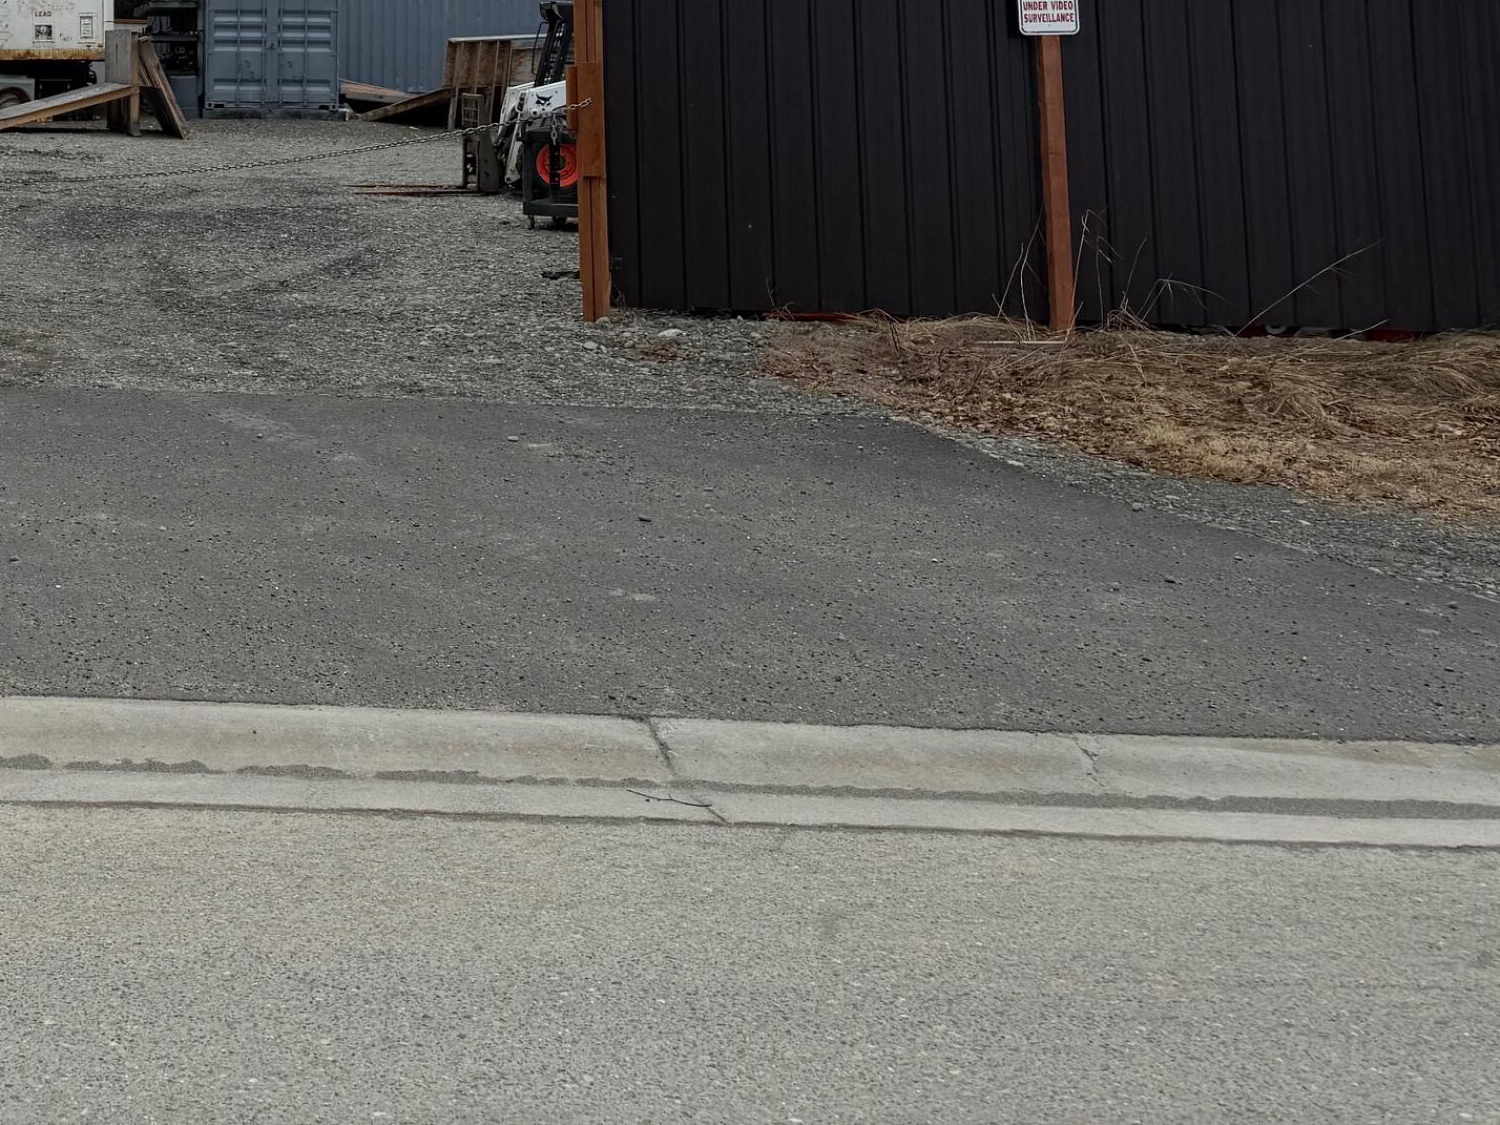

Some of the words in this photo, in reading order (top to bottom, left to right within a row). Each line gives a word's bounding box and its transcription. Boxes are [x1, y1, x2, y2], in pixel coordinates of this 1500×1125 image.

[1023, 1, 1048, 11] UNDER
[1051, 1, 1073, 10] VIDEO
[1024, 13, 1074, 23] SURVEILLANCE
